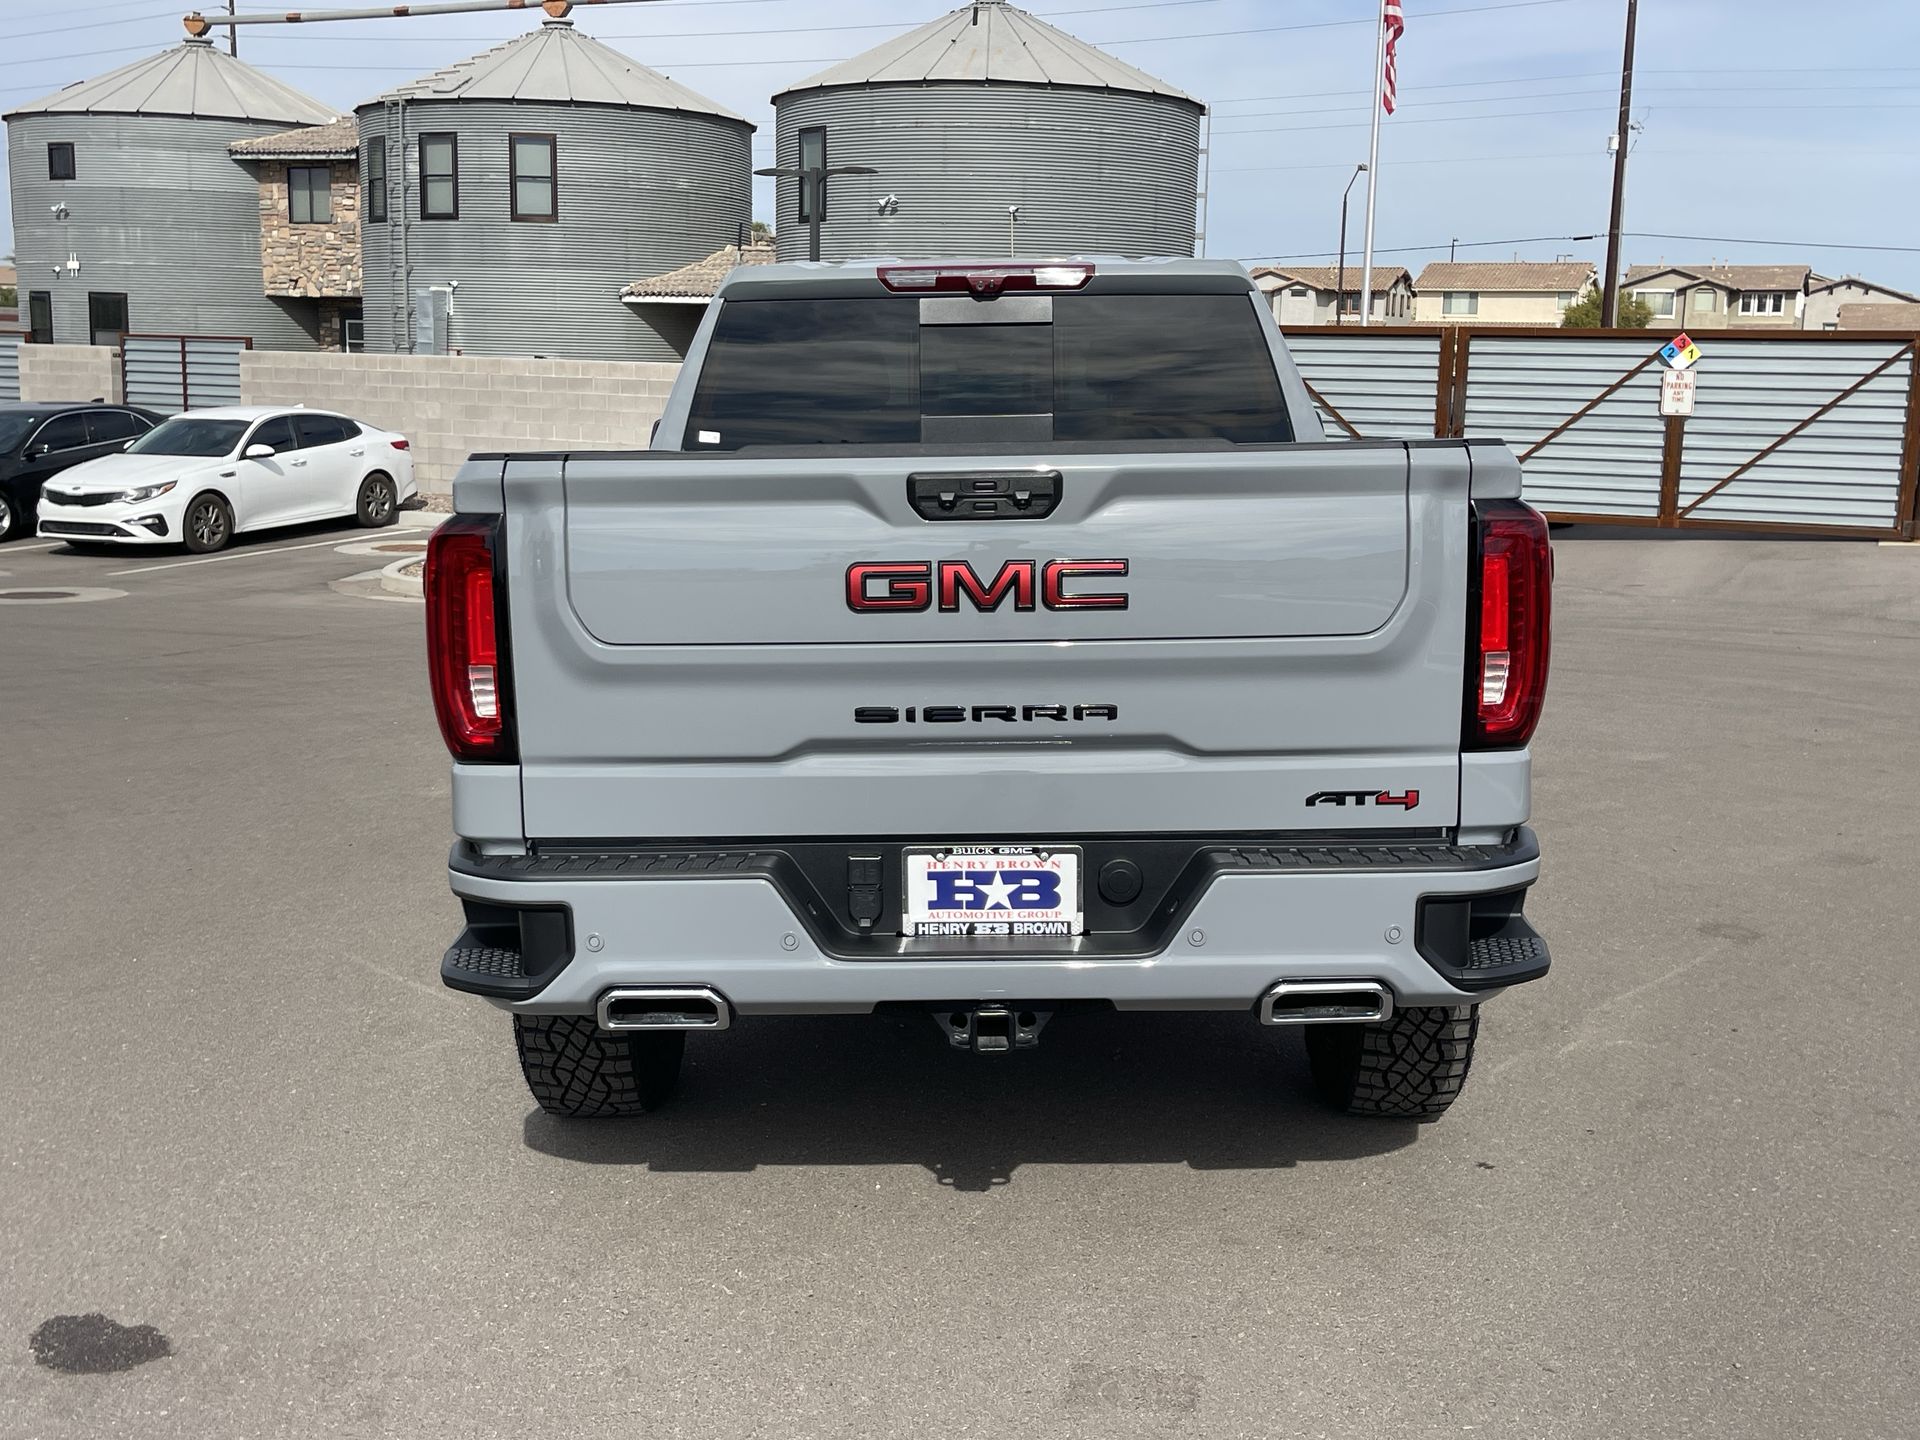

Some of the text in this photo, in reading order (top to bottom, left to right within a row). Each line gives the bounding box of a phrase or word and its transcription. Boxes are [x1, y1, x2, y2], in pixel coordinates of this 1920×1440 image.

[1679, 338, 1686, 348] 3
[1667, 347, 1675, 358] 2
[1688, 349, 1694, 359] 1
[1667, 382, 1692, 390] PARKING
[845, 558, 1129, 614] GMC
[854, 704, 1118, 723] SIERRA
[1305, 790, 1419, 811] AT4
[952, 847, 994, 855] BUICK
[927, 860, 1062, 870] HENRY BROWN
[928, 911, 1062, 919] AUTOMOTIVE GROUP
[918, 923, 969, 935] HENRY
[1014, 922, 1068, 935] BROWN
